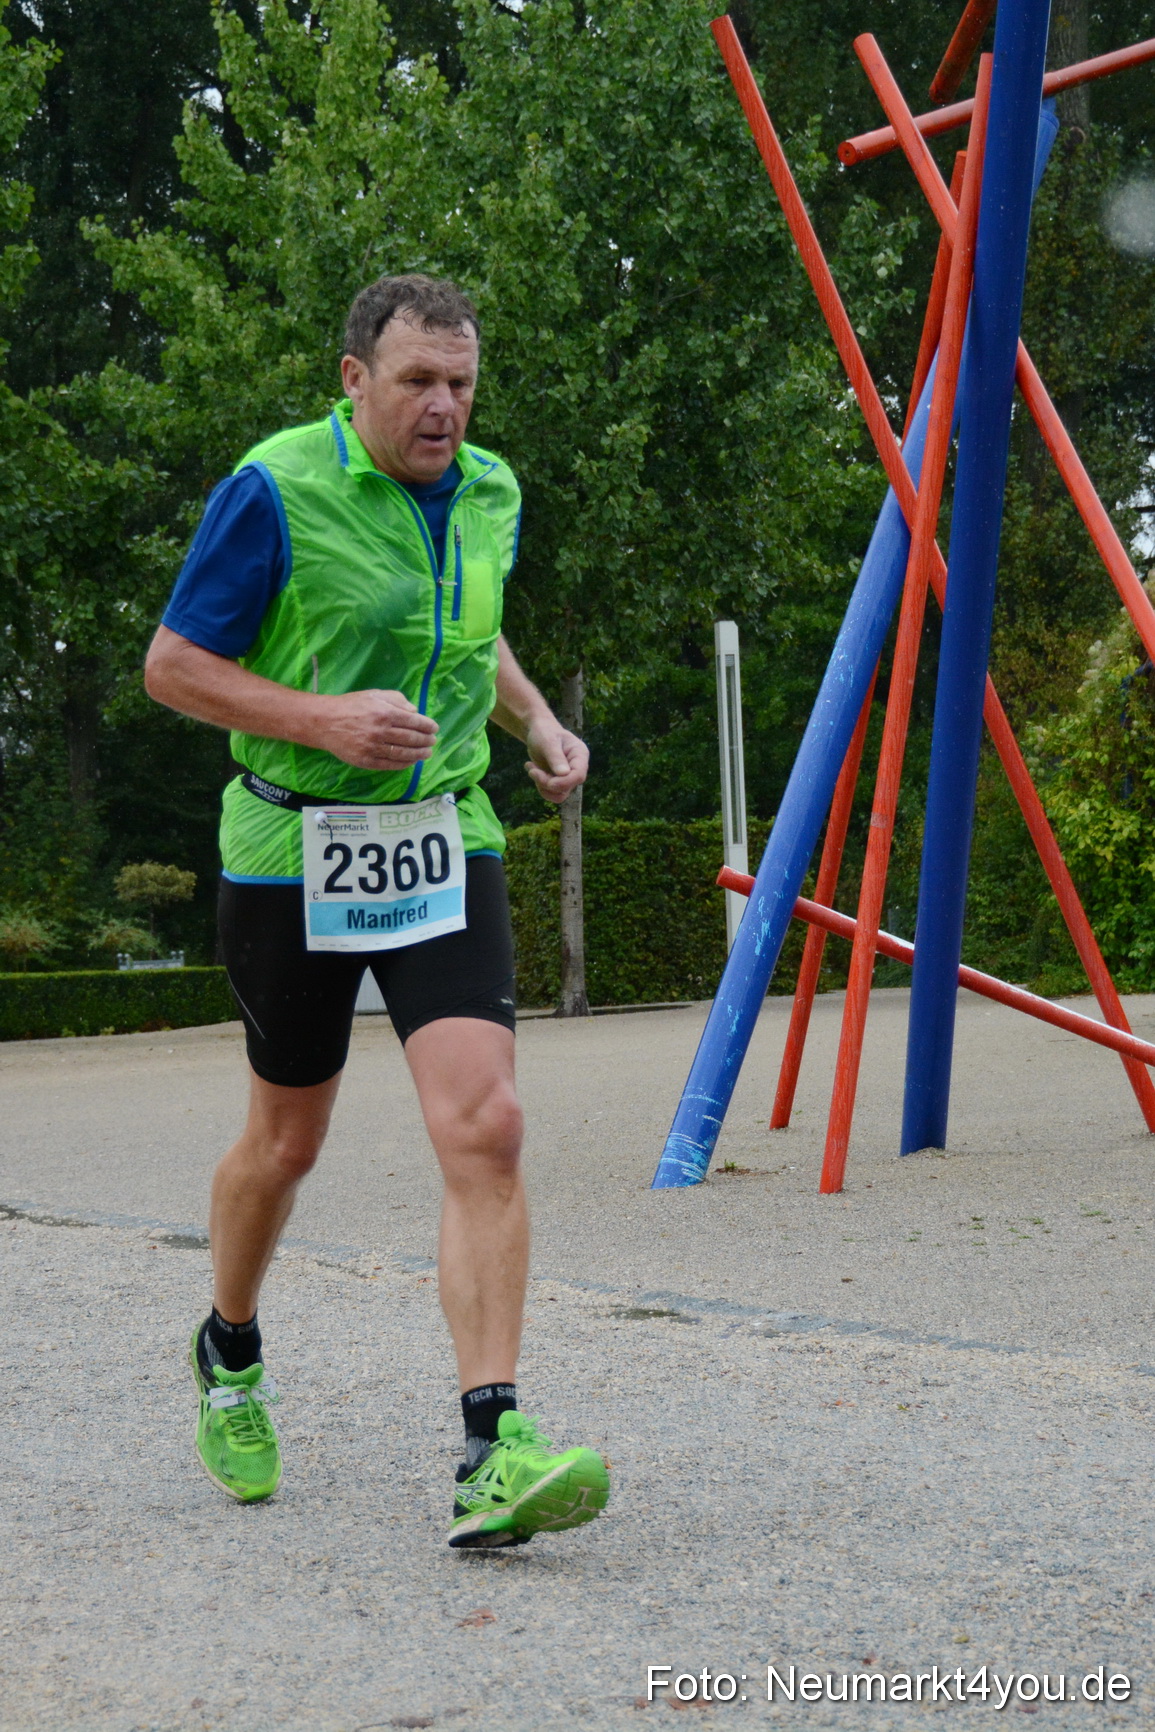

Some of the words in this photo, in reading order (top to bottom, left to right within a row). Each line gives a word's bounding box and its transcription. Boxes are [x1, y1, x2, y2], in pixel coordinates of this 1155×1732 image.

[250, 774, 292, 800] SAUCONY
[379, 800, 442, 829] BOCK
[323, 832, 450, 894] 2360
[312, 891, 319, 900] C
[347, 901, 428, 929] Manfred
[468, 1387, 493, 1404] TECH
